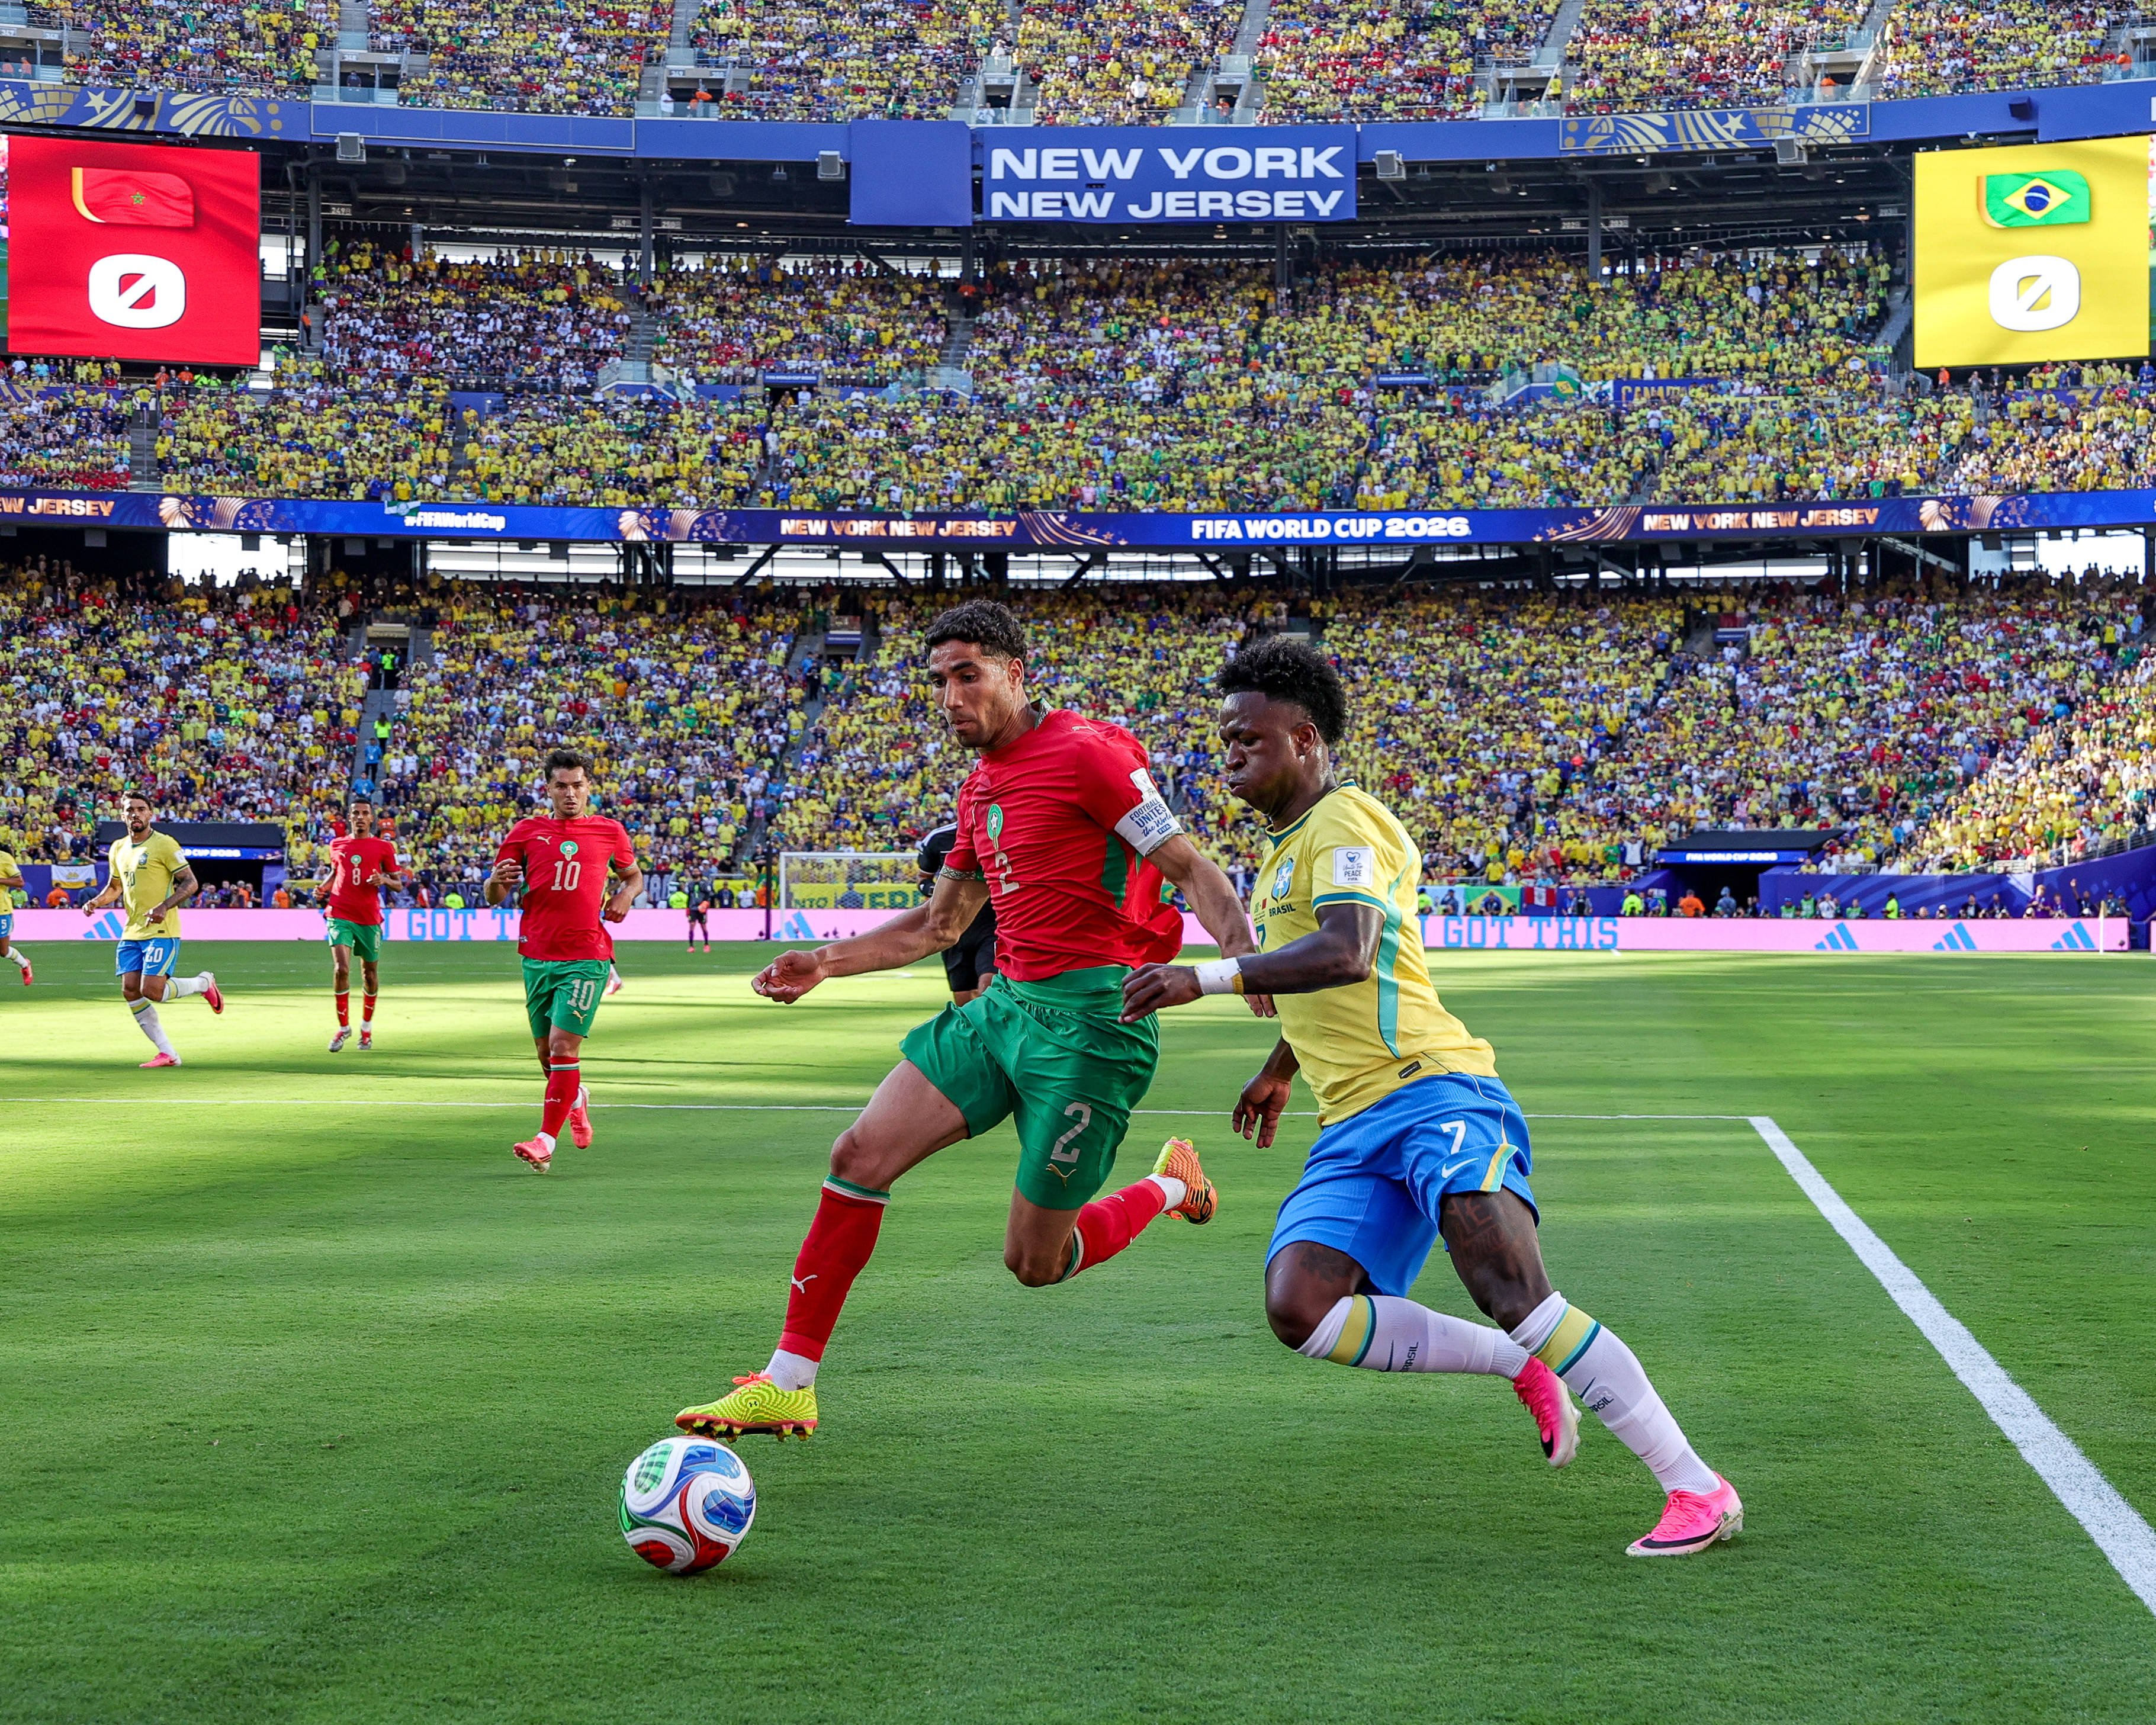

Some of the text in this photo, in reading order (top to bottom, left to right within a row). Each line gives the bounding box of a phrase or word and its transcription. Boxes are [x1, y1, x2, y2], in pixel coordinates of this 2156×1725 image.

[991, 147, 1344, 179] NEW YORK
[991, 190, 1344, 219] NEW JERSEY
[88, 253, 186, 329] 0
[1988, 255, 2080, 332] 0
[28, 498, 115, 516] JERSEY
[1643, 507, 1879, 531] NEW YORK NEW JERSEY
[404, 511, 506, 532] #FIFAWorldCup
[780, 519, 1017, 537] NEW YORK NEW JERSEY
[1191, 516, 1470, 539] FIFA WORLD CUP 2026
[1129, 798, 1160, 822] FOOTBALL
[1135, 804, 1167, 828] UNITES
[1142, 825, 1155, 837] the
[1686, 853, 1704, 861] FIFA
[1704, 853, 1732, 862] WORLD
[1733, 853, 1749, 861] CUP
[352, 867, 362, 886] 8
[551, 860, 581, 891] 10
[995, 850, 1020, 895] 2
[1269, 903, 1296, 917] BRASIL
[407, 908, 477, 940] GOT
[1255, 923, 1267, 949] 7
[1444, 916, 1514, 947] GOT
[1529, 917, 1618, 949] THIS
[145, 947, 164, 963] 20
[567, 978, 596, 1011] 10
[1050, 1101, 1092, 1163] 2
[1440, 1120, 1467, 1155] 7
